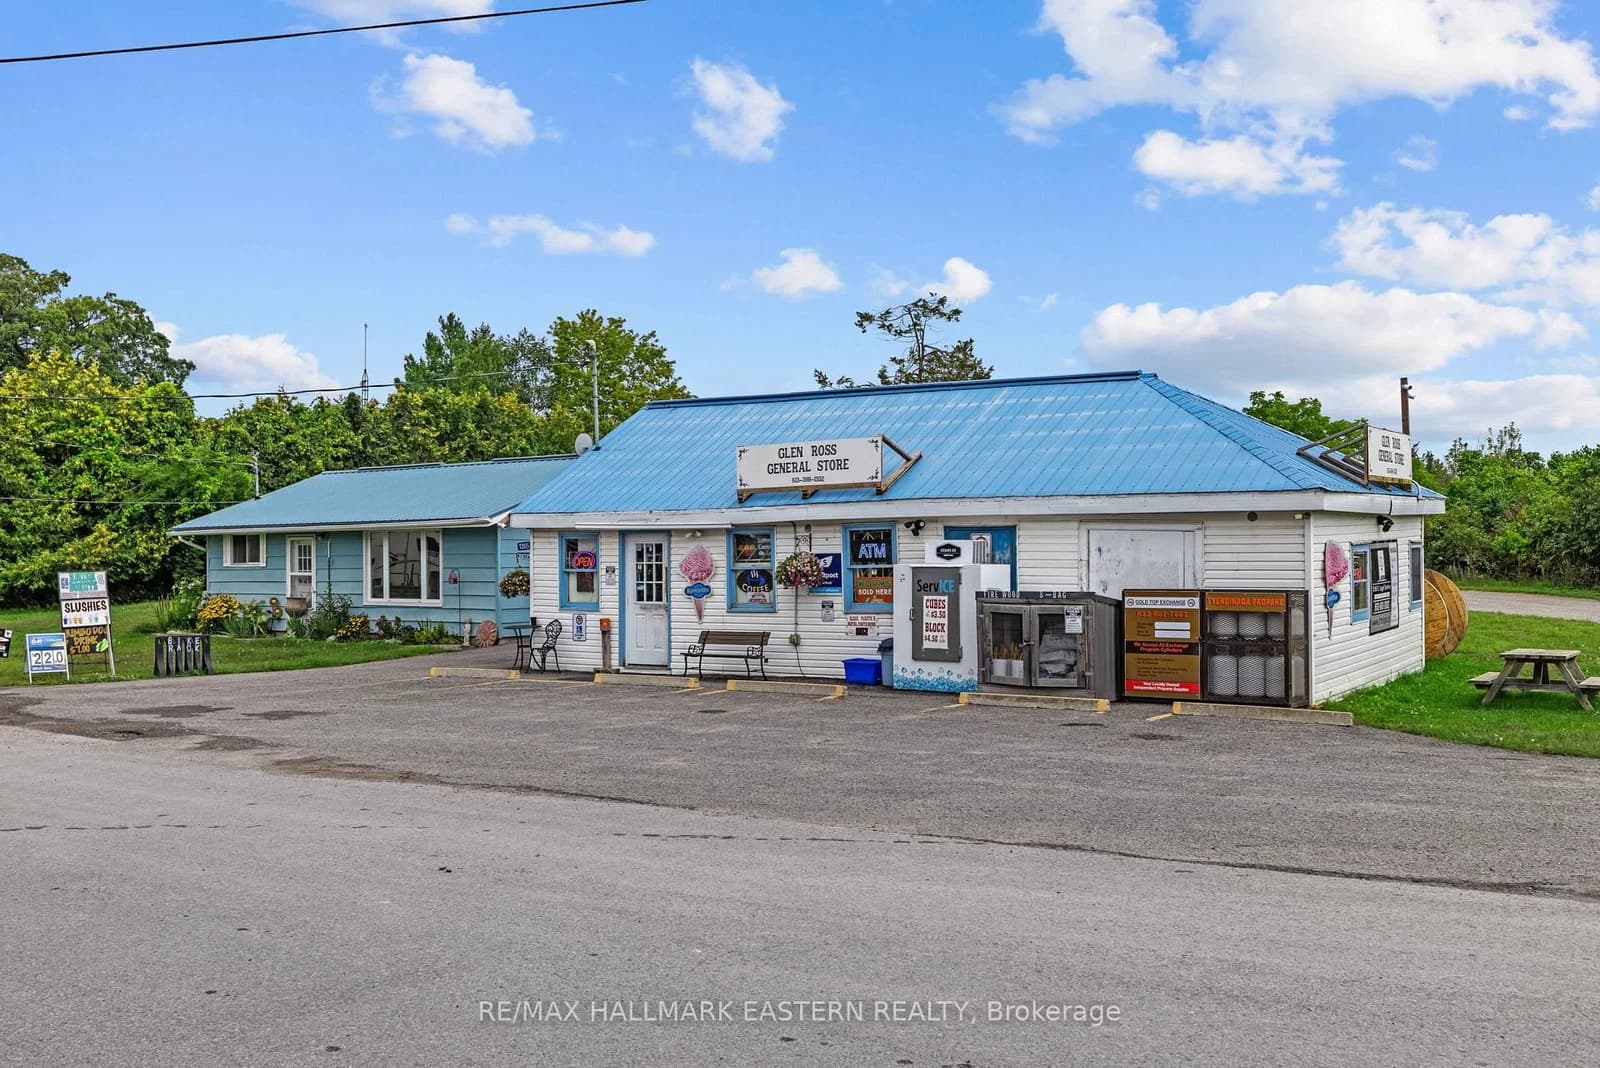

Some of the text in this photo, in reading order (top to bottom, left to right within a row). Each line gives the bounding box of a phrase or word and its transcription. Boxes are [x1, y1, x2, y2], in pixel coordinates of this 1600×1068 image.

[778, 444, 837, 459] GLEN ROSS
[767, 459, 849, 474] GENERAL STORE
[858, 543, 886, 558] ATM
[575, 556, 593, 567] OPEN
[741, 583, 770, 593] COFFEE
[64, 600, 107, 613] SLUSHIES
[925, 599, 946, 609] CUBES
[931, 610, 946, 618] $3.50
[65, 628, 92, 637] JUMBO
[925, 622, 946, 633] BLOCK
[74, 635, 98, 645] DRINK
[168, 636, 200, 645] BIKE
